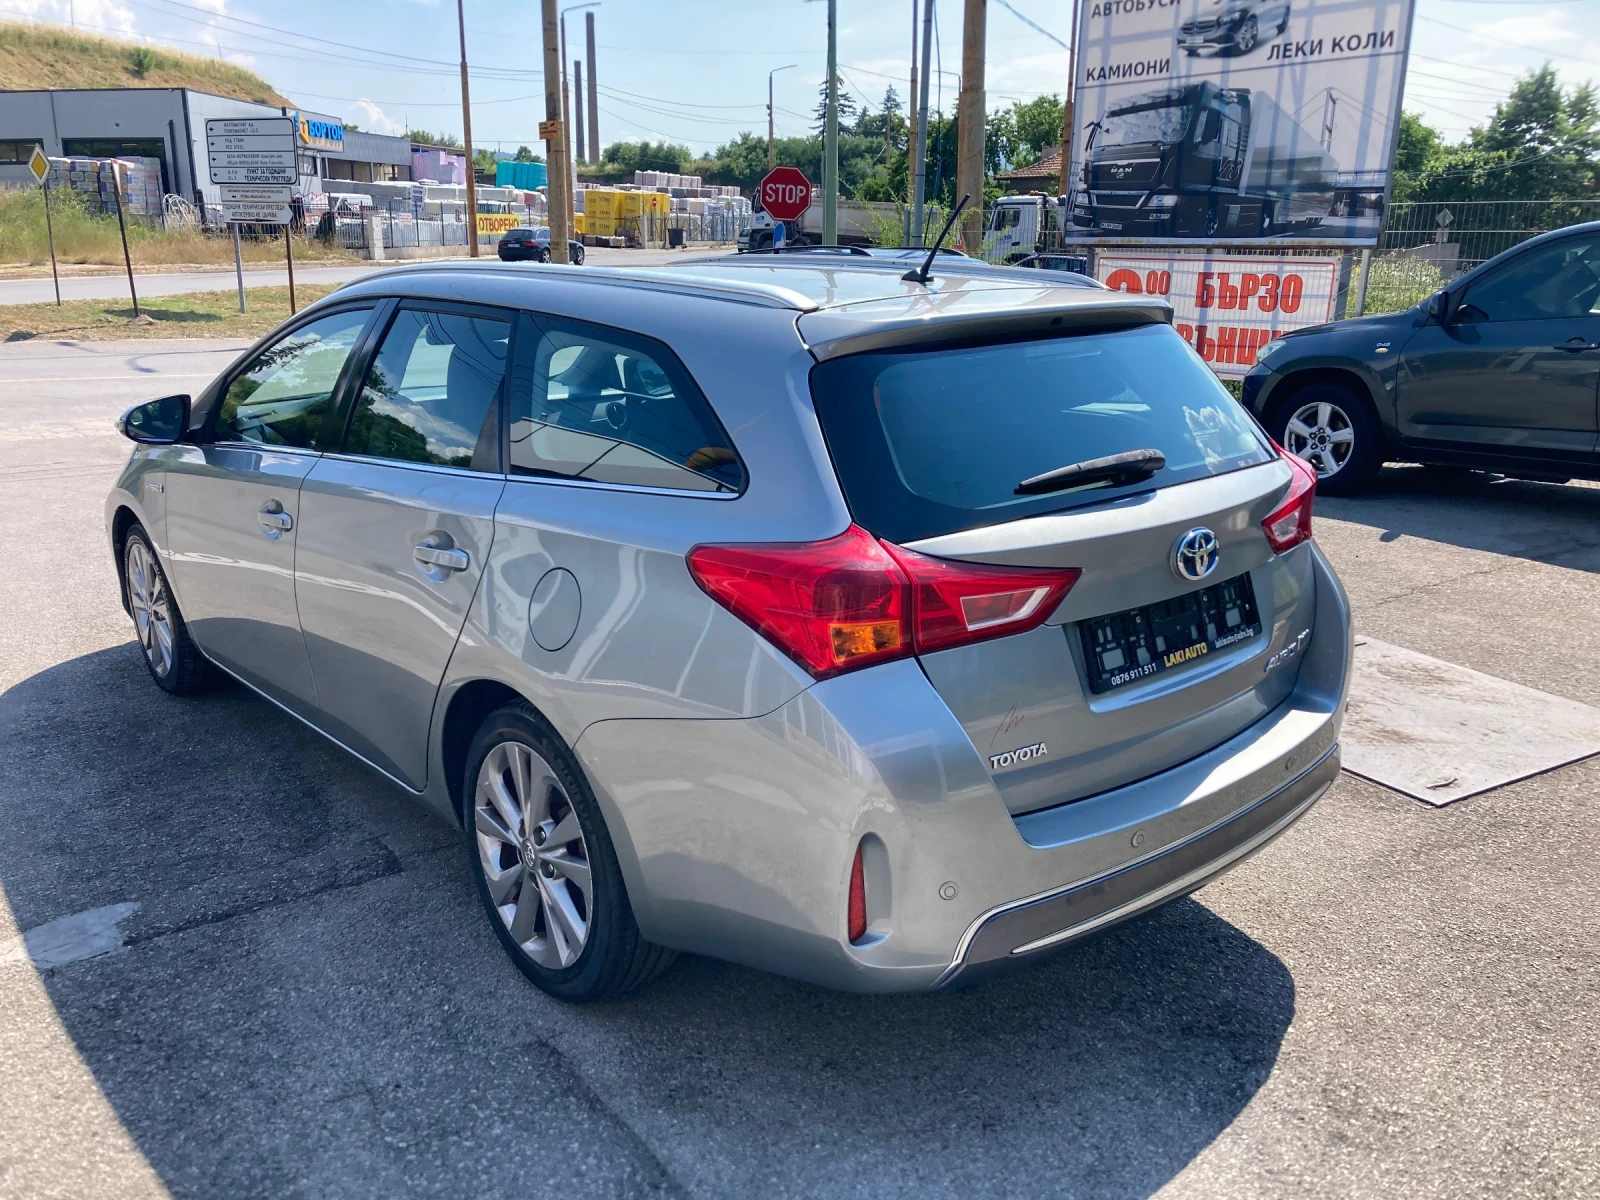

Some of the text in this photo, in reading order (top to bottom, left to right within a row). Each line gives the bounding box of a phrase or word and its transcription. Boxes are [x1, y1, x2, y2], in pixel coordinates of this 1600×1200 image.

[1266, 30, 1395, 61] ЛЕКИ КОЛИ
[1085, 58, 1170, 83] КАМИОНИ
[308, 119, 344, 141] БОРТОН
[765, 183, 807, 204] STOP
[478, 216, 520, 232] ОТВОРЕНО
[1194, 271, 1303, 314] БЪРЗО
[1111, 672, 1130, 686] 0876
[1130, 667, 1143, 679] 911
[1144, 662, 1157, 675] 511
[989, 742, 1048, 769] TOYOTA
